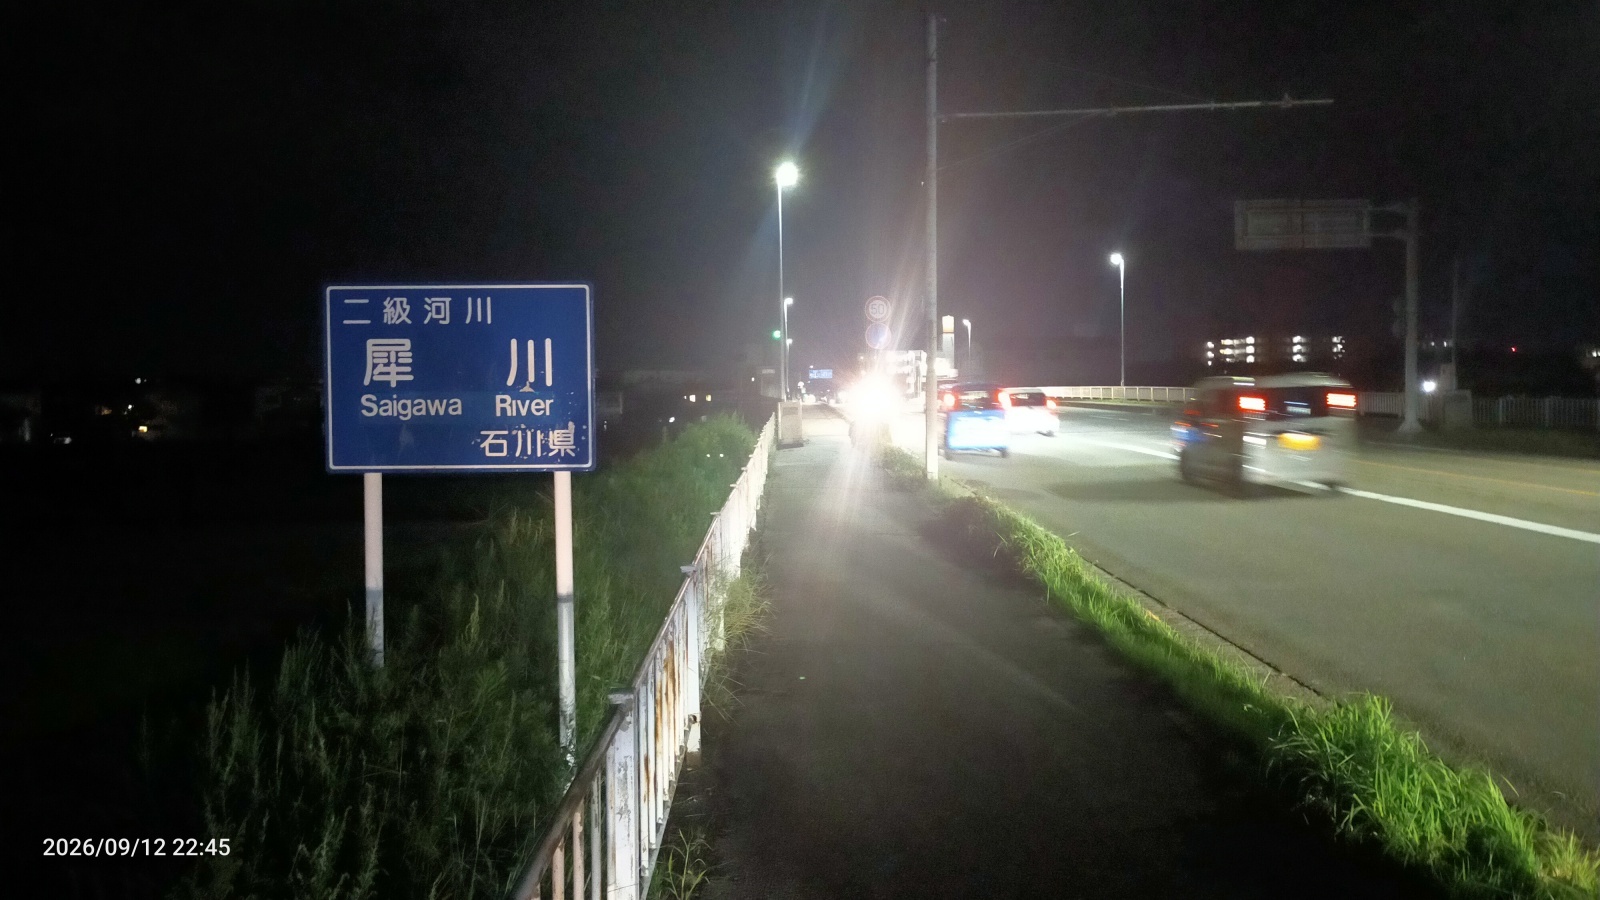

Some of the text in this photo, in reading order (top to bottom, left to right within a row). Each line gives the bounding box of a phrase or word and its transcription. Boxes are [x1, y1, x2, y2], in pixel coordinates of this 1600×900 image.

[342, 296, 492, 325] 二級河川
[871, 303, 885, 316] 50
[360, 394, 554, 421] Saigawa River
[479, 428, 577, 458] 石川県
